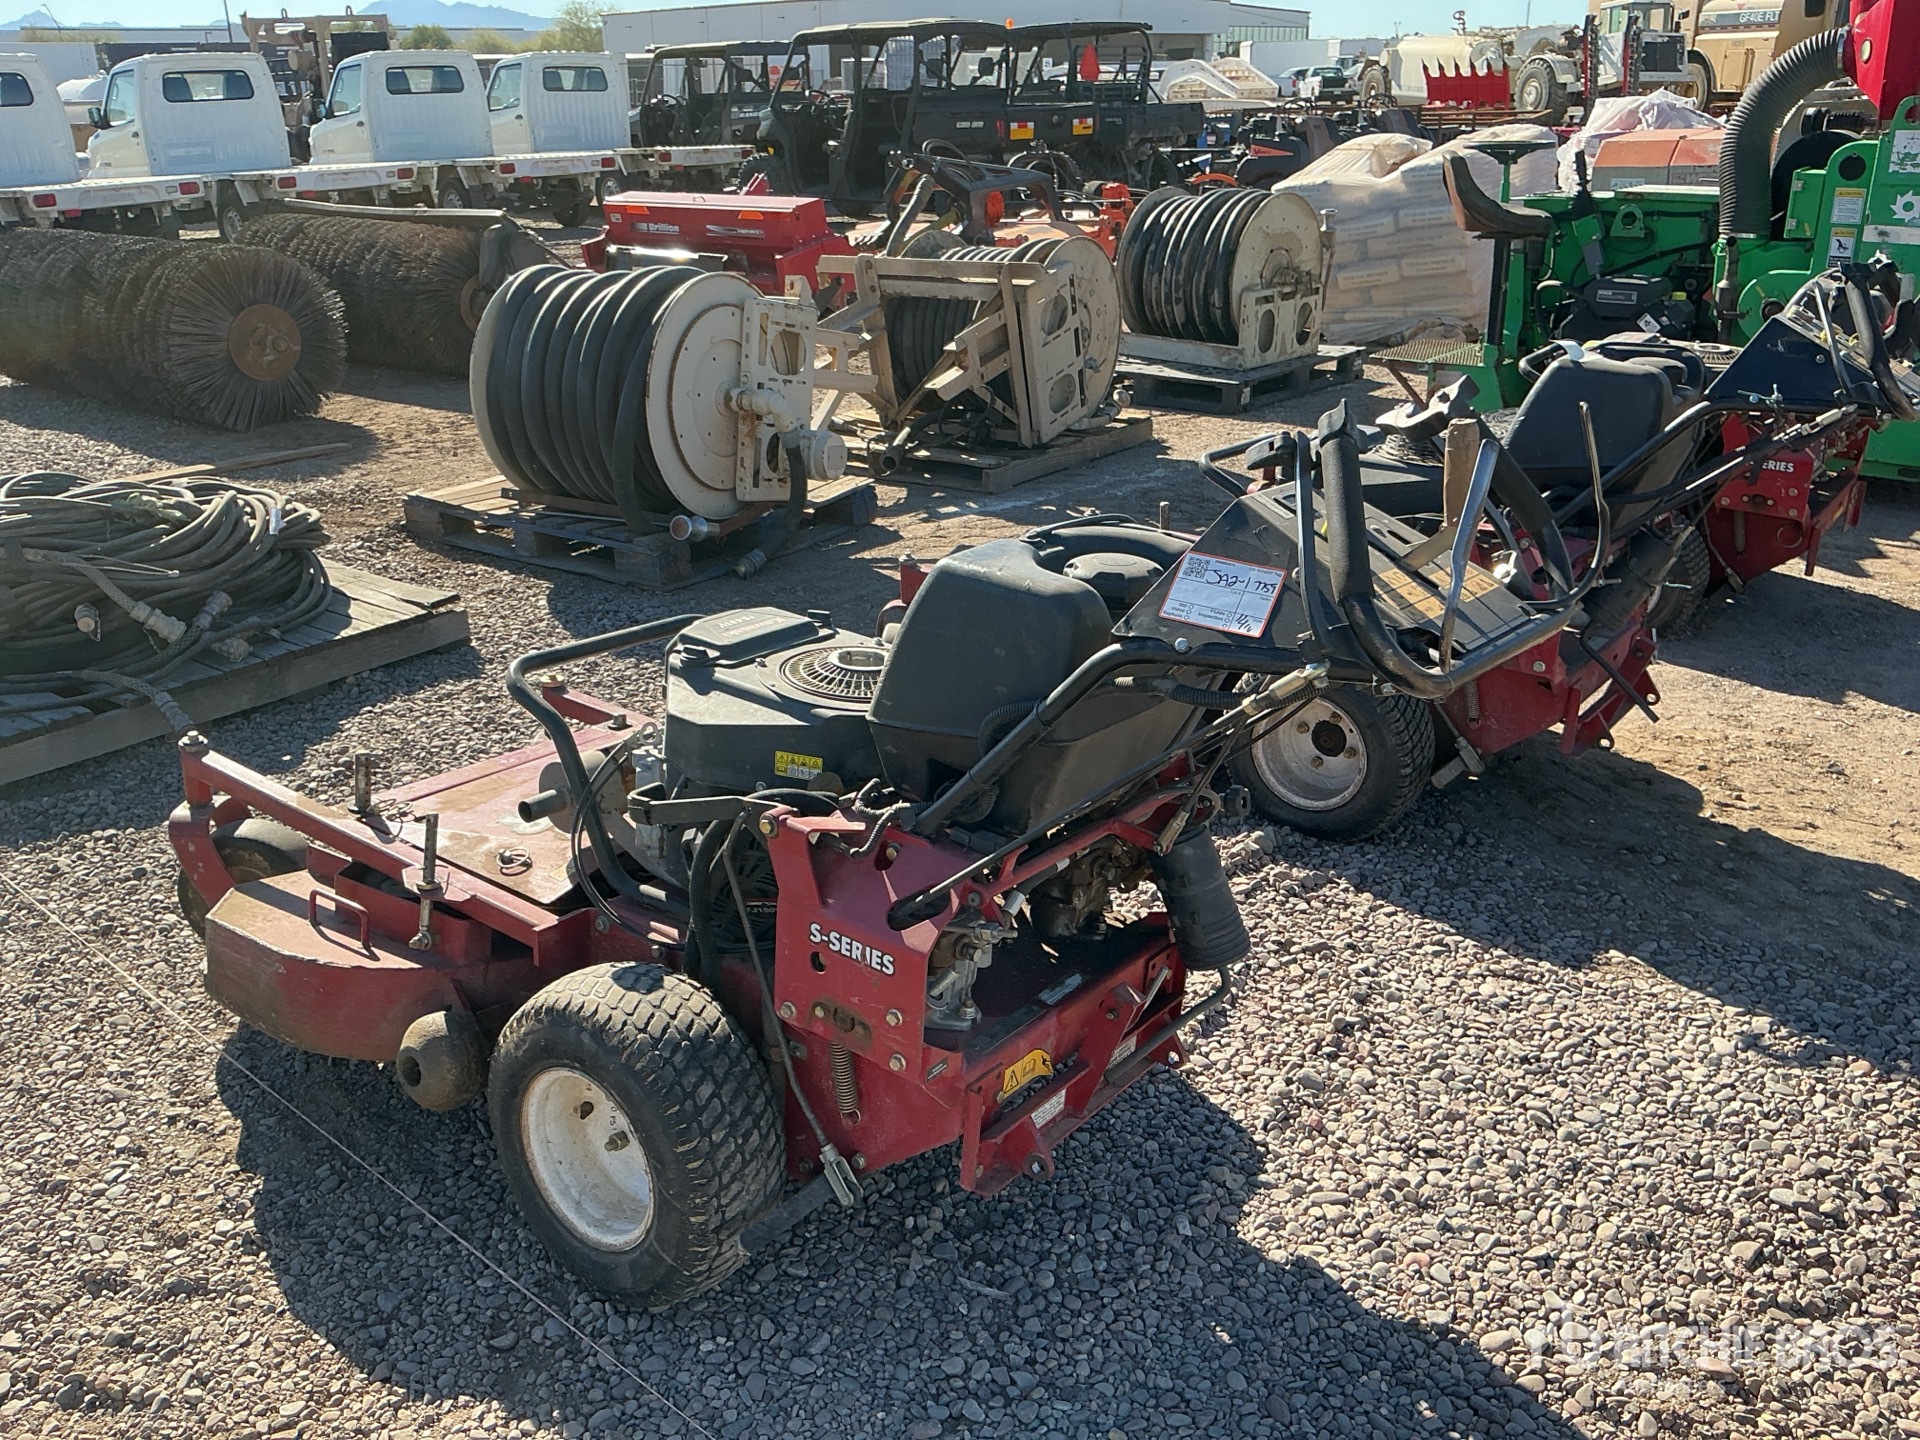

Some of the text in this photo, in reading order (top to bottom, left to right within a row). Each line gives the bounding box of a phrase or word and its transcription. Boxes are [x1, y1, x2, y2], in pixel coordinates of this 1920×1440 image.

[1765, 11, 1780, 21] FLT
[1762, 460, 1795, 473] ERIES
[1197, 612, 1224, 621] Inspection
[809, 923, 895, 975] S-SERIES
